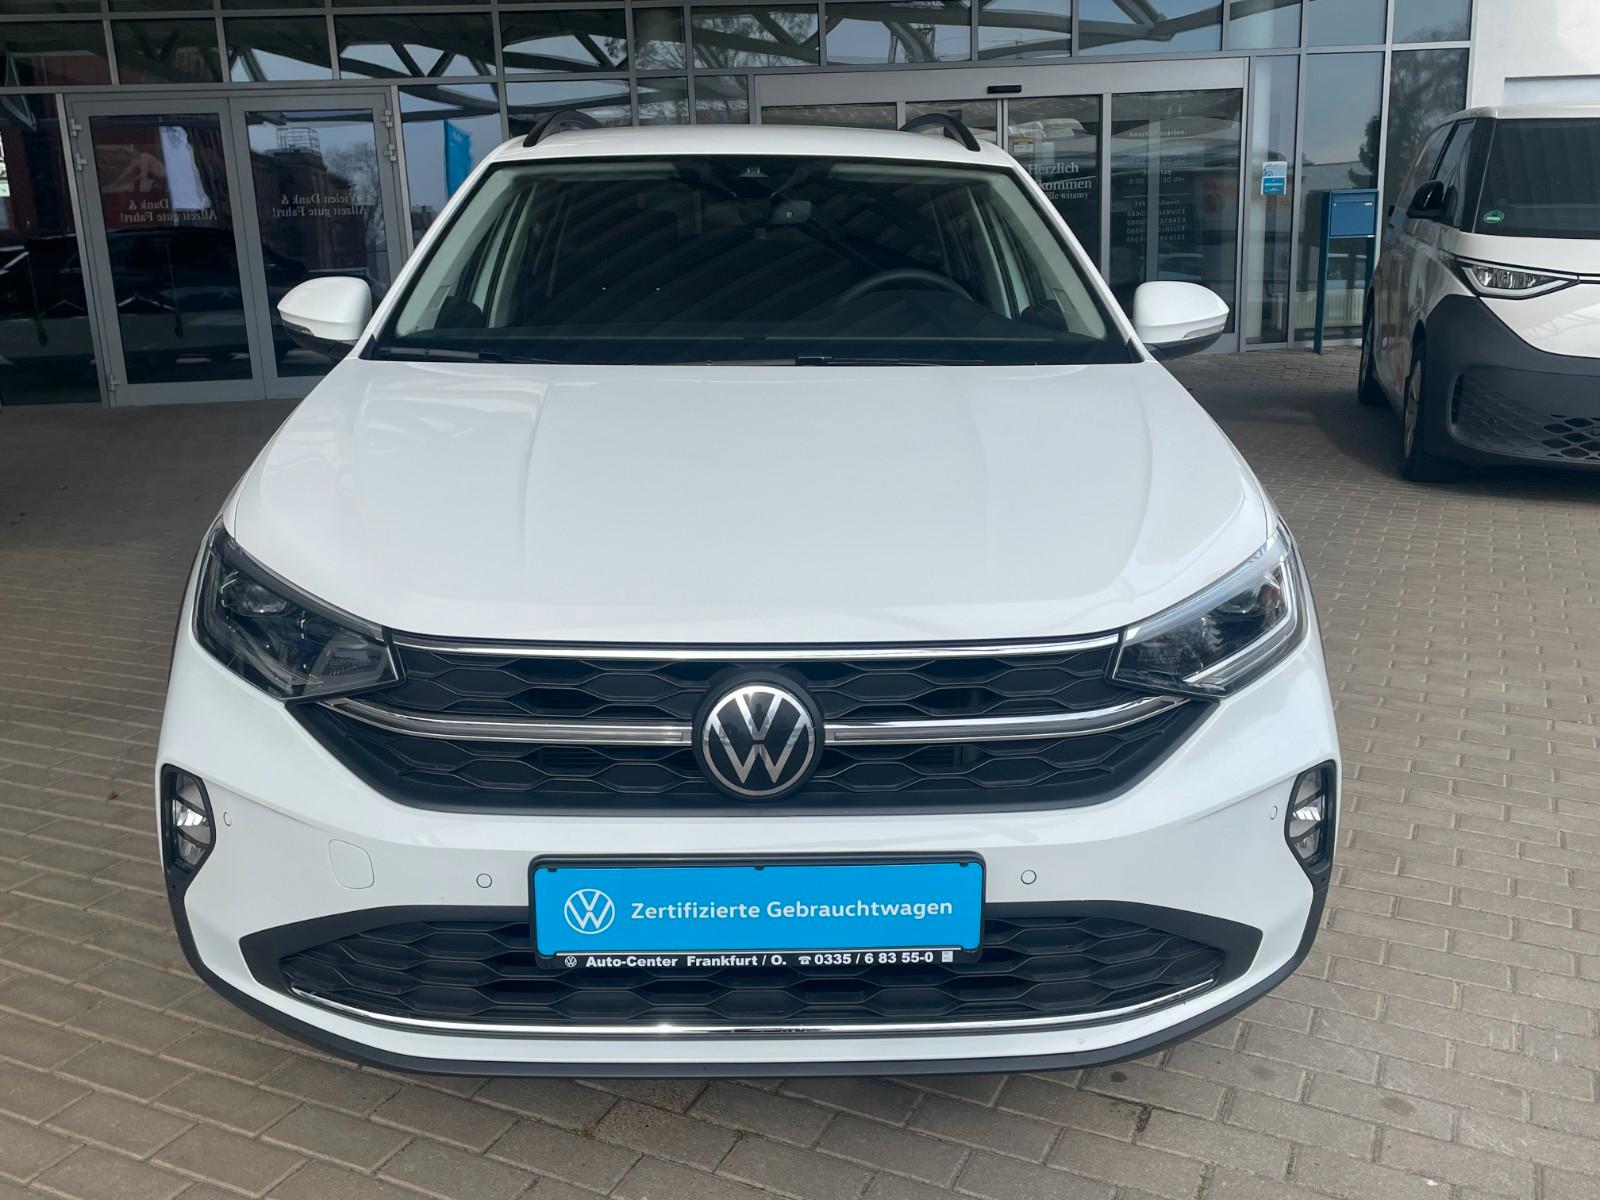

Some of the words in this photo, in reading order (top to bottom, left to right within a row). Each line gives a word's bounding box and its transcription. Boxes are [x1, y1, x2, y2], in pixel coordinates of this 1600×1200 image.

[1028, 161, 1080, 175] Herzlich
[1038, 179, 1093, 191] kommen
[631, 900, 761, 920] Zertifizierte
[766, 899, 953, 919] Gebrauchtwagen
[585, 956, 679, 968] Auto-Center
[686, 955, 759, 967] Frankfurt
[770, 954, 787, 966] O.
[814, 953, 852, 965] 0335
[864, 952, 875, 964] 6
[878, 952, 897, 964] 83
[901, 951, 934, 964] 55-0
